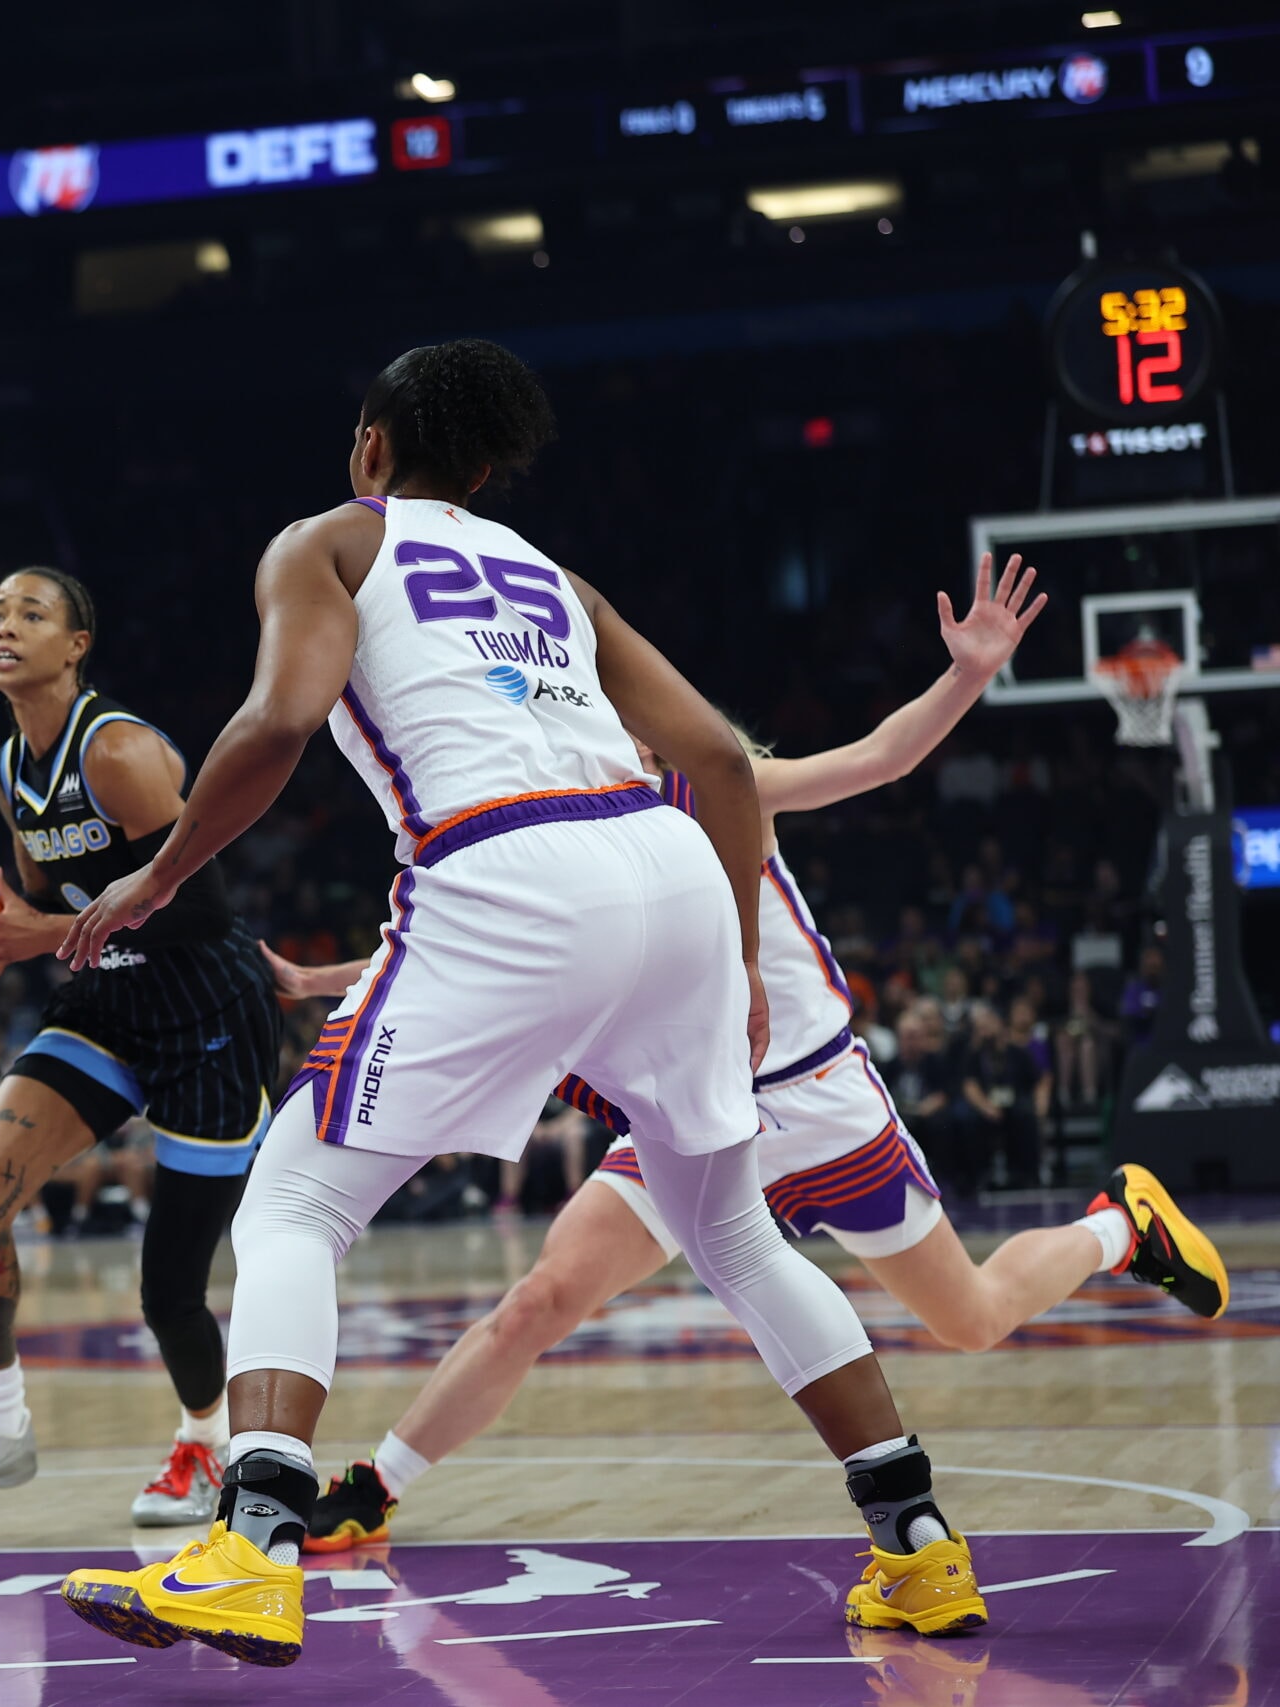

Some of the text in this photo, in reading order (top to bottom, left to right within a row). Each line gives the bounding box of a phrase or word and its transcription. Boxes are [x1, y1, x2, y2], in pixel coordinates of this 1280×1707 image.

[903, 66, 1057, 113] MERCURY
[1184, 45, 1215, 88] 9
[206, 118, 376, 189] DEFE
[1100, 286, 1188, 337] 5:32
[1116, 329, 1184, 405] 12
[1106, 422, 1207, 456] TISSOT
[394, 539, 571, 642] 25
[465, 629, 570, 669] THOMAS
[16, 816, 112, 863] HICAGO
[357, 1024, 397, 1126] PHOENIX
[945, 1564, 959, 1577] 24
